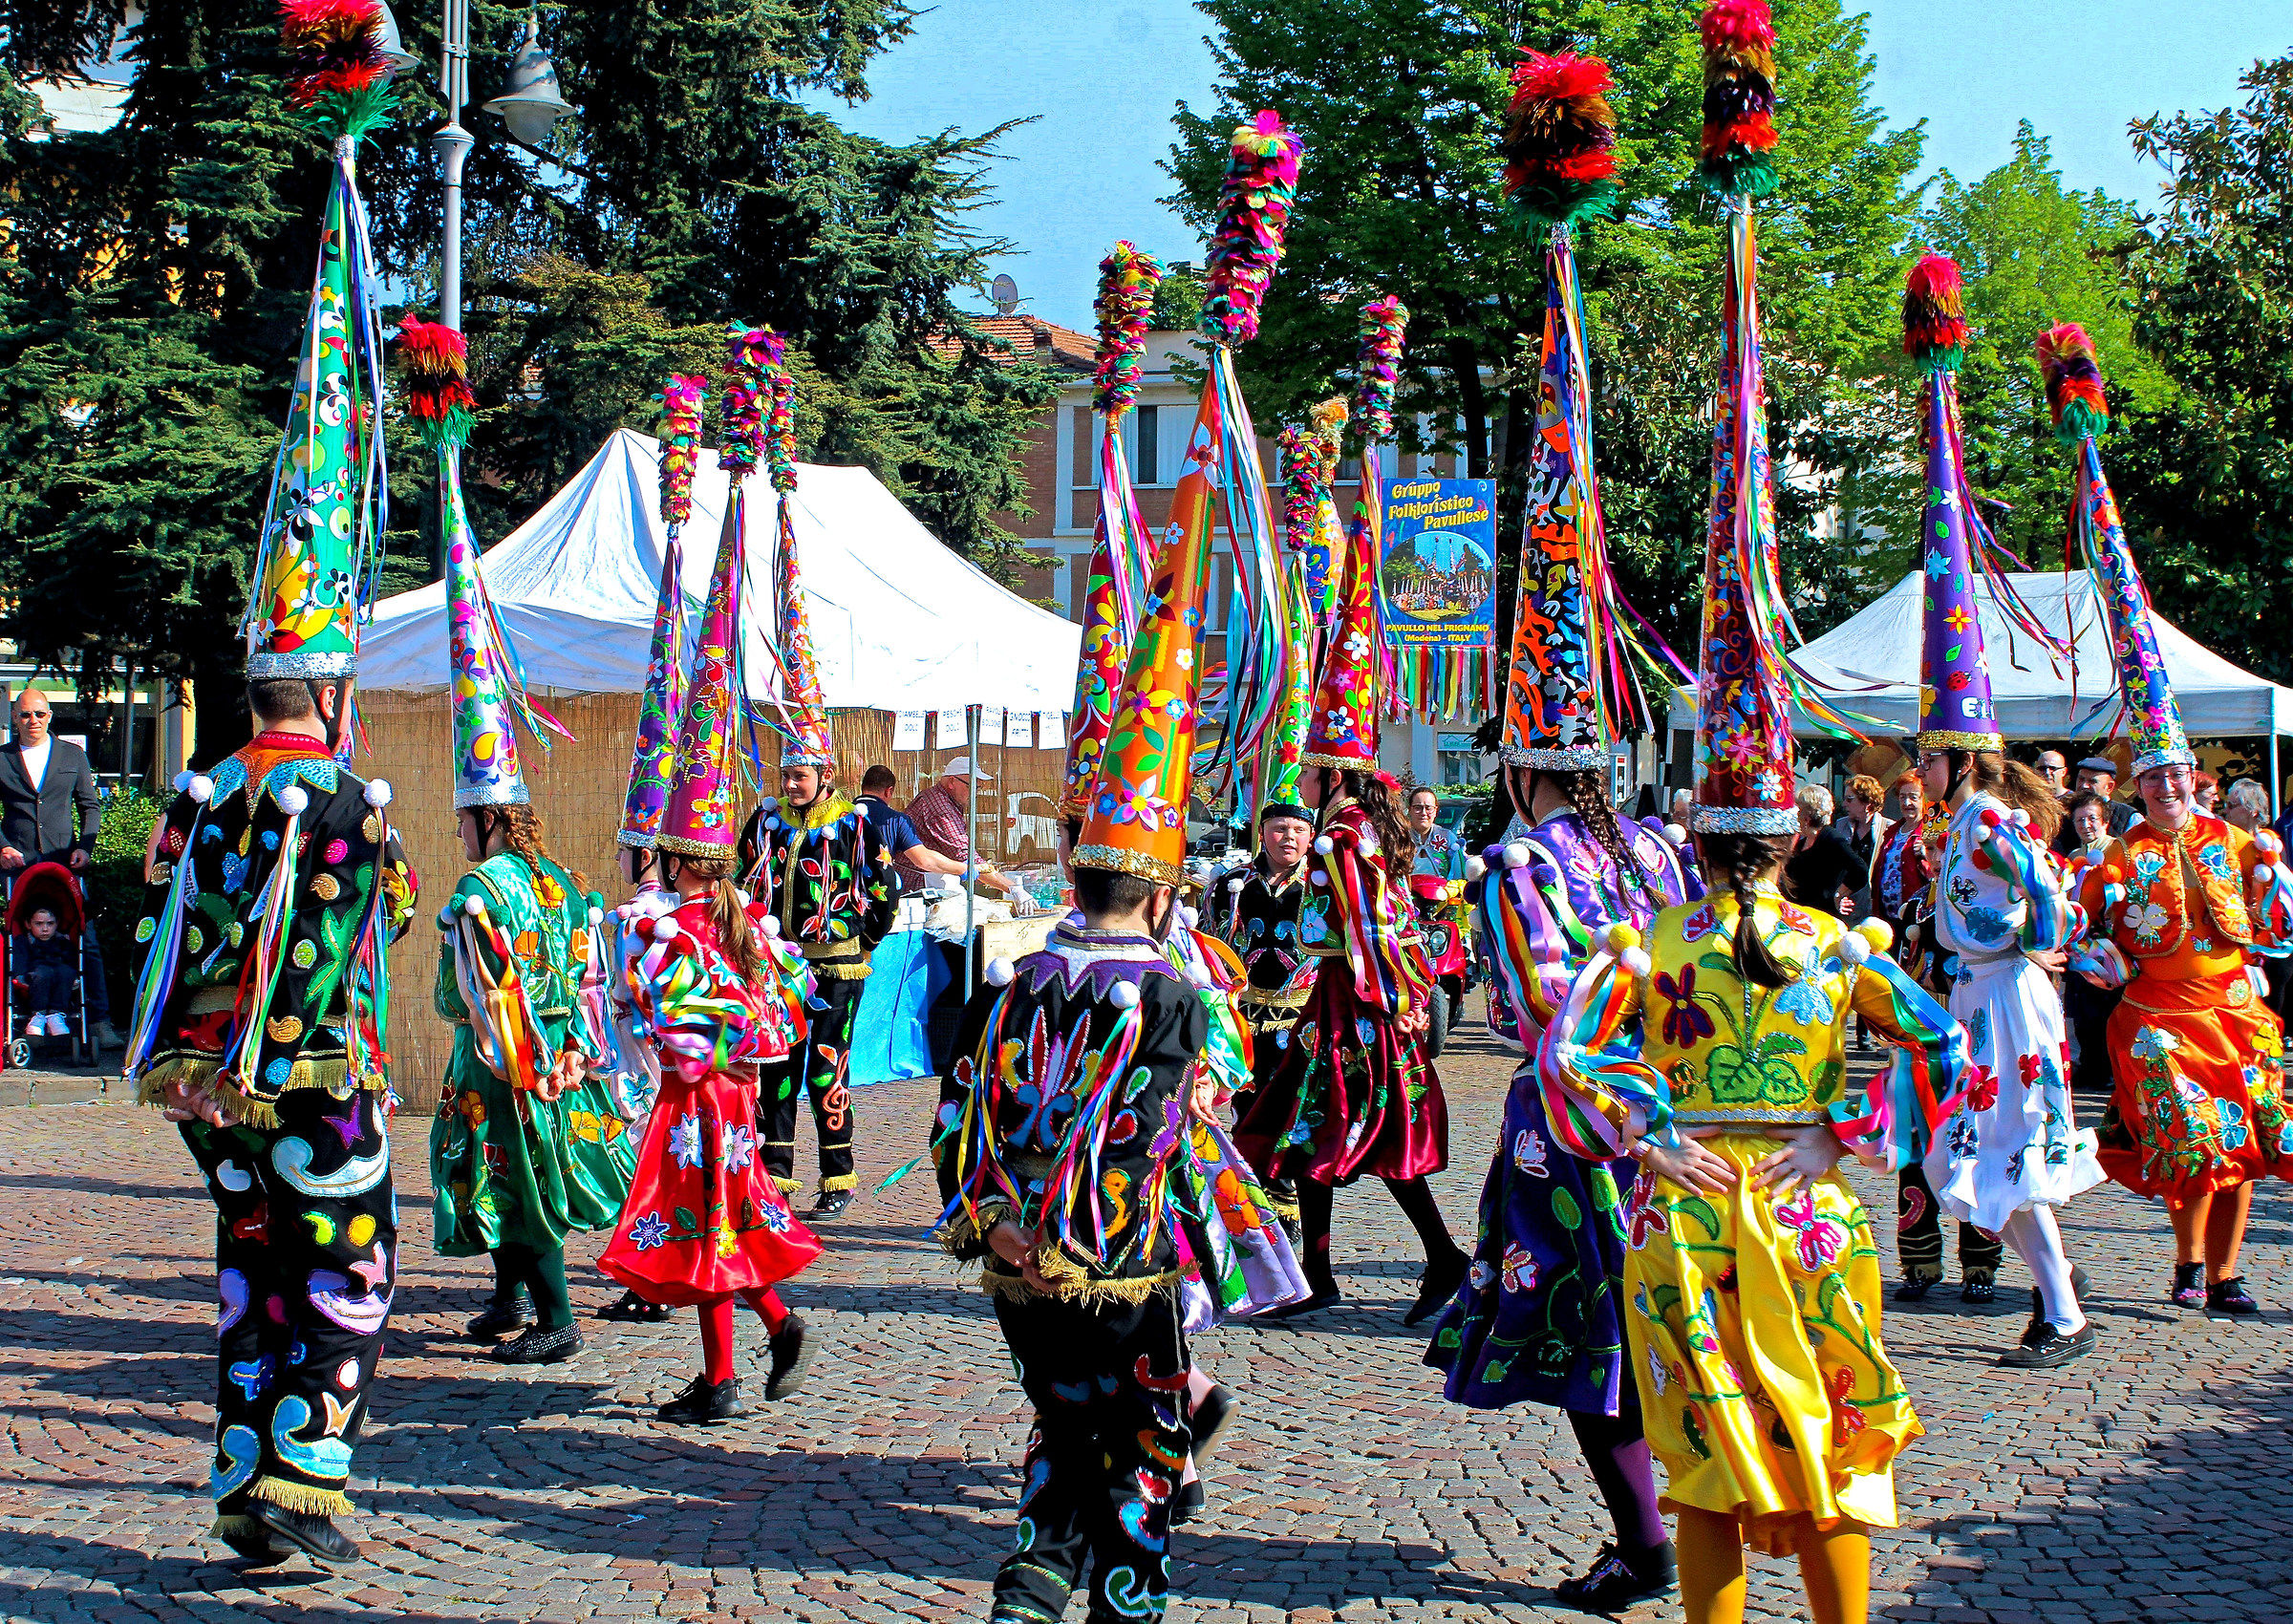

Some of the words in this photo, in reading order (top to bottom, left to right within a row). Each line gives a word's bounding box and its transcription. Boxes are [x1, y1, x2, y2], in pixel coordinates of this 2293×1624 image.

[1392, 481, 1441, 499] Gruppo
[1388, 494, 1473, 520] Folkloristico
[1424, 509, 1489, 529] Pavullese
